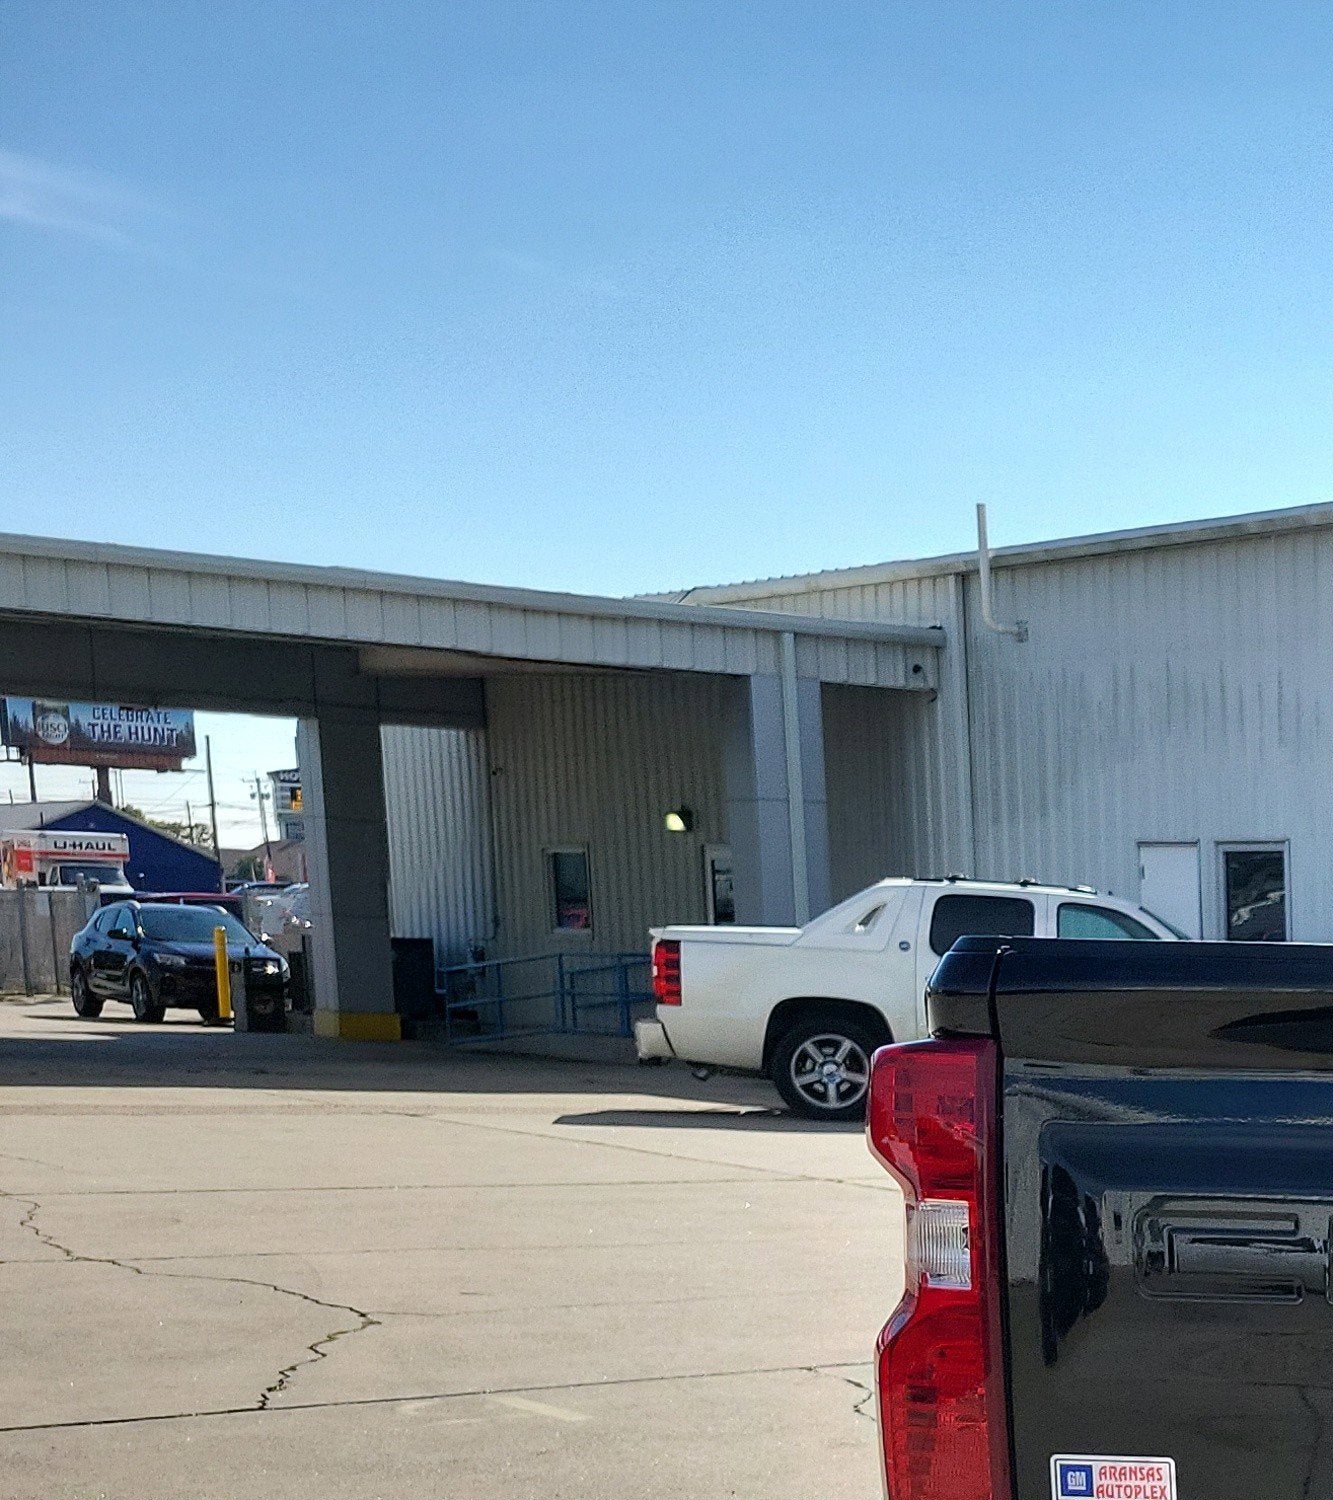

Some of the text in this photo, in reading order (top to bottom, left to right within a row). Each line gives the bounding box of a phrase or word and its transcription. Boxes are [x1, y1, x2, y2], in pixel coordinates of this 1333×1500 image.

[92, 707, 171, 724] CELEBRATE
[88, 722, 178, 747] THE HUNT
[53, 840, 117, 851] U-HAUL
[1067, 1471, 1086, 1487] GM
[1098, 1466, 1163, 1482] ARANSAS
[1096, 1484, 1168, 1500] AUTOPLEX
